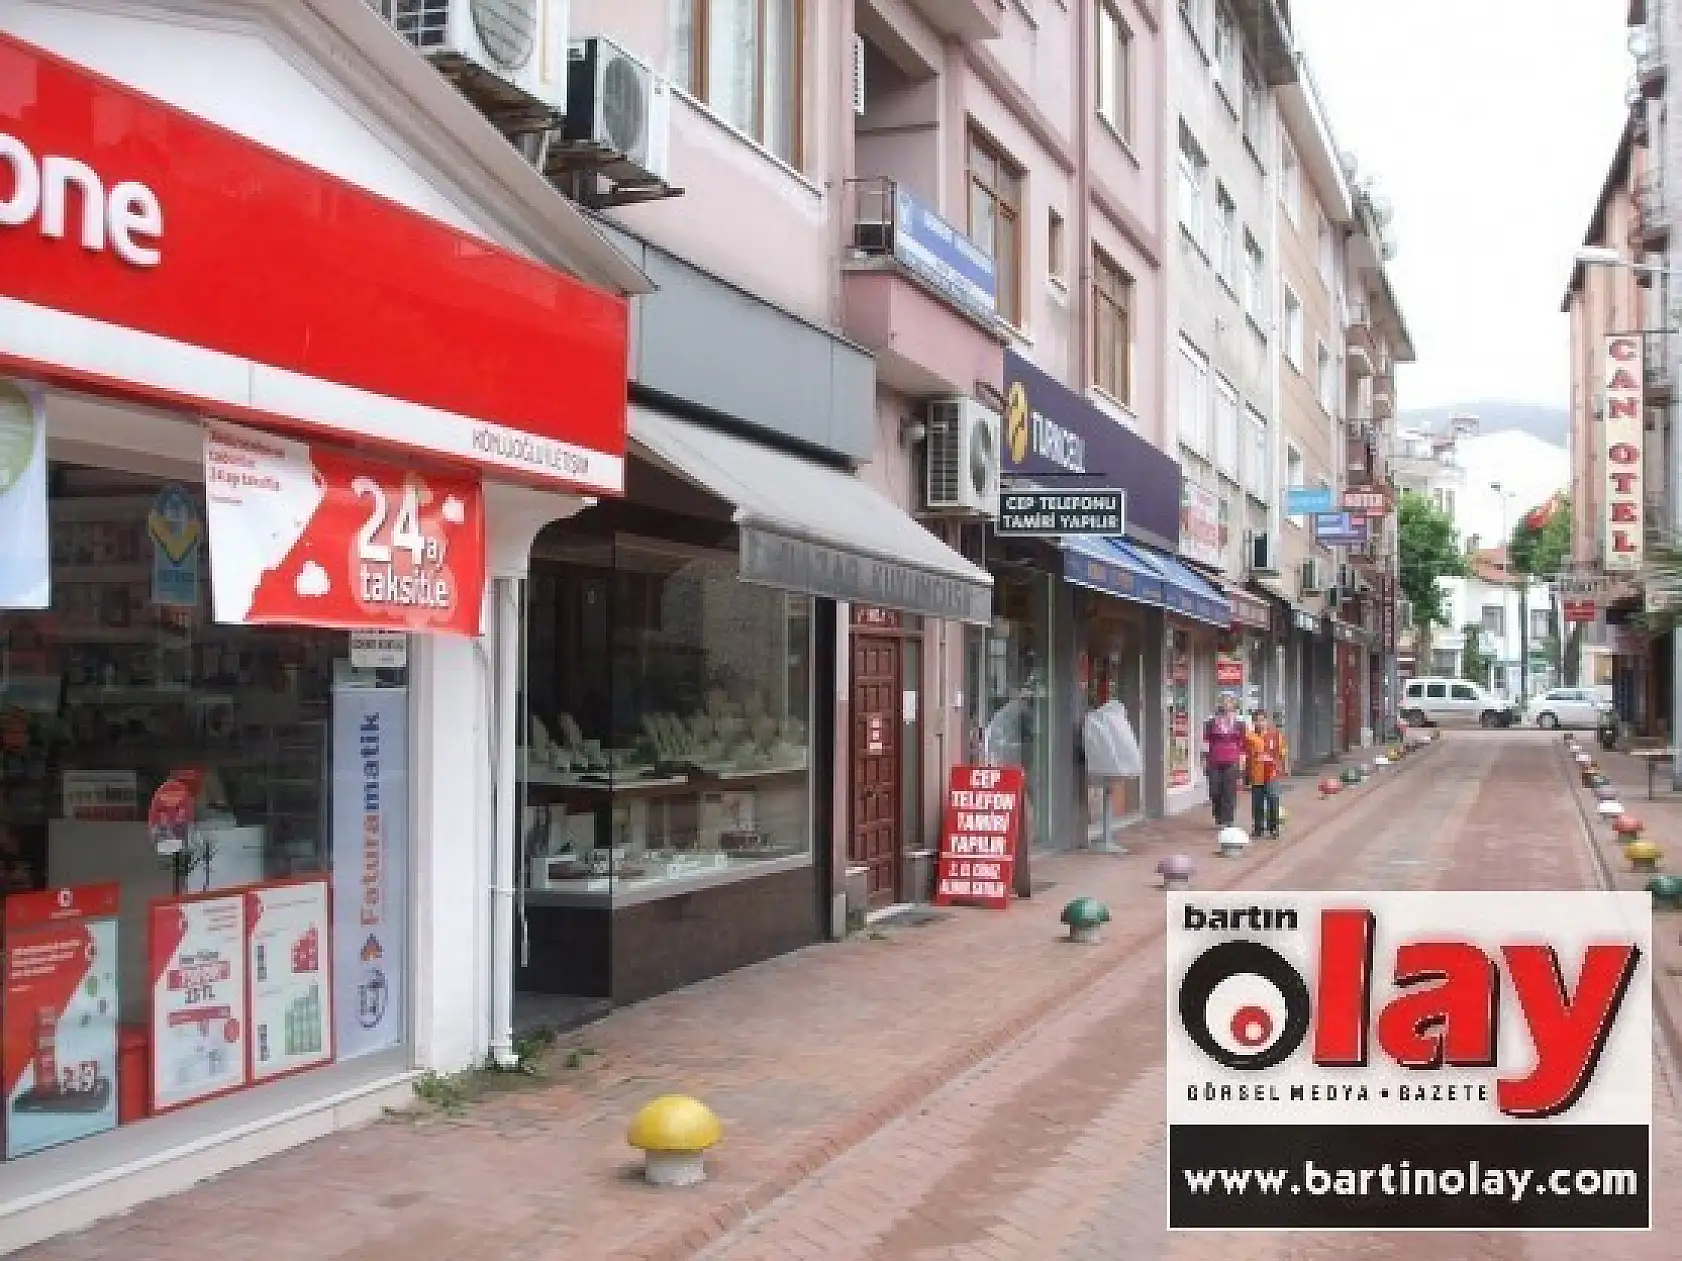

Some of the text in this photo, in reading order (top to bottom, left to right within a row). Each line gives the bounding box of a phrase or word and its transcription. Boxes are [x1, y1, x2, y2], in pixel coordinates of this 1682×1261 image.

[1607, 339, 1641, 553] CAN OTEL
[1005, 496, 1034, 510] CEP
[352, 475, 425, 565] 24
[1060, 514, 1119, 528] YAPILIR
[360, 563, 450, 609] taksitle
[969, 769, 1001, 789] CEP
[951, 790, 1016, 810] TELEFON
[360, 711, 380, 926] Faturamatik
